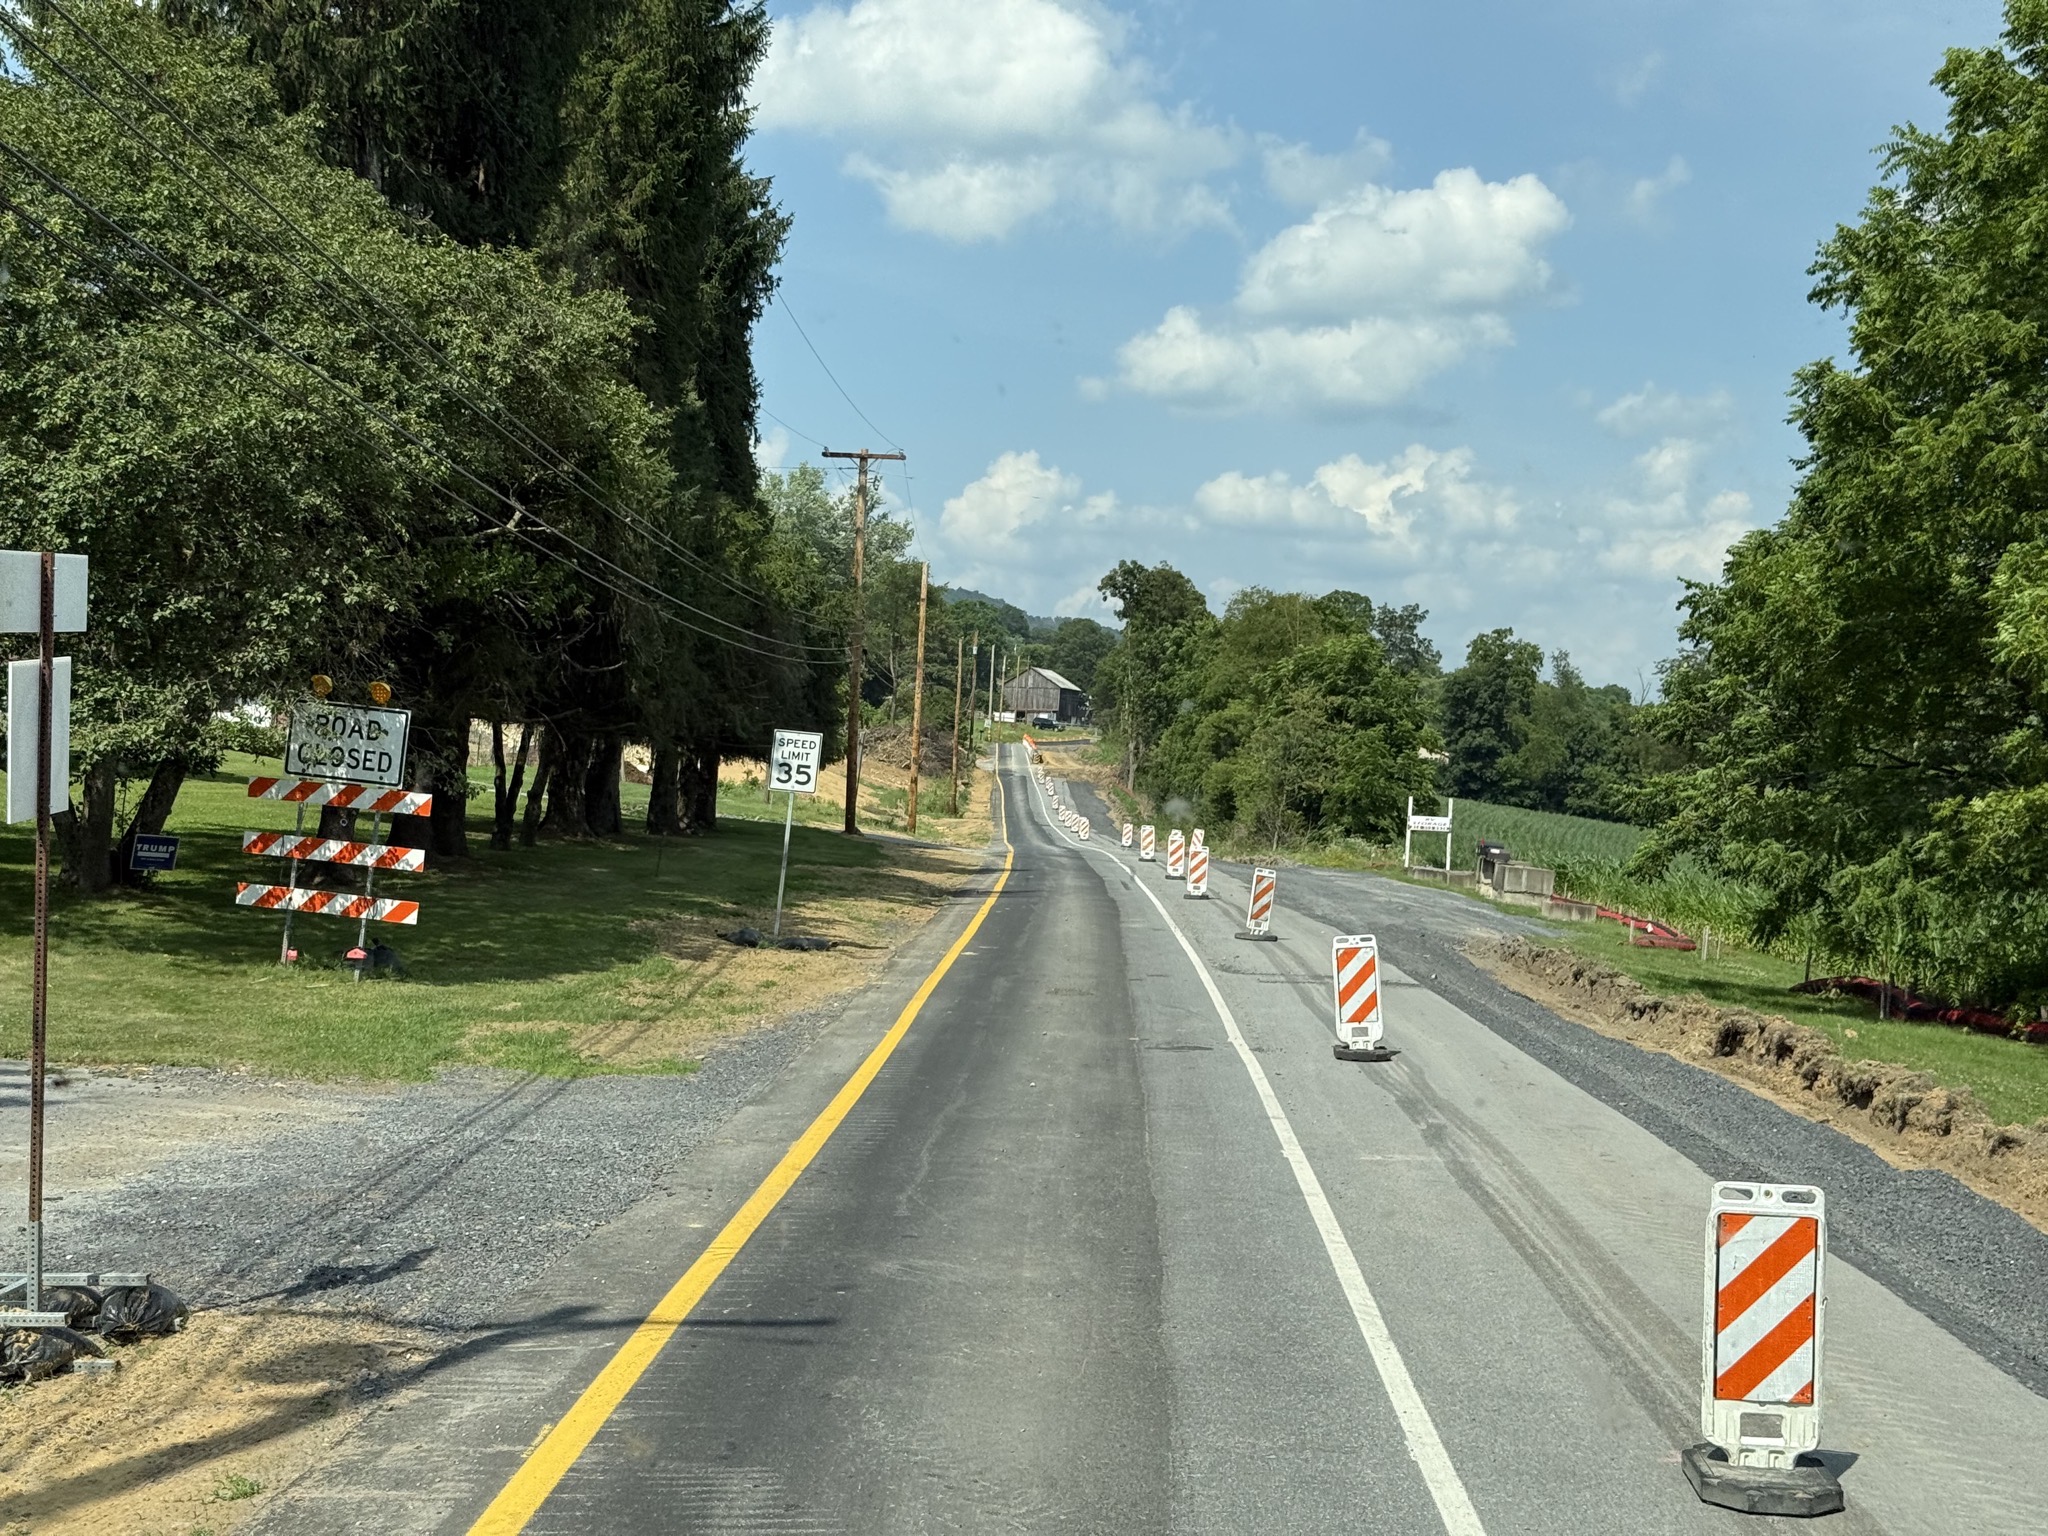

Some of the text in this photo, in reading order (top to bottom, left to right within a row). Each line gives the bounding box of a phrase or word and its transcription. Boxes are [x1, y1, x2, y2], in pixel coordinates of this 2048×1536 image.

[315, 714, 381, 741] ROAD
[778, 737, 817, 750] SPEED
[298, 742, 393, 773] CLOSED
[781, 750, 811, 762] LIMIT
[776, 762, 812, 786] 35
[136, 843, 176, 853] TRUMP
